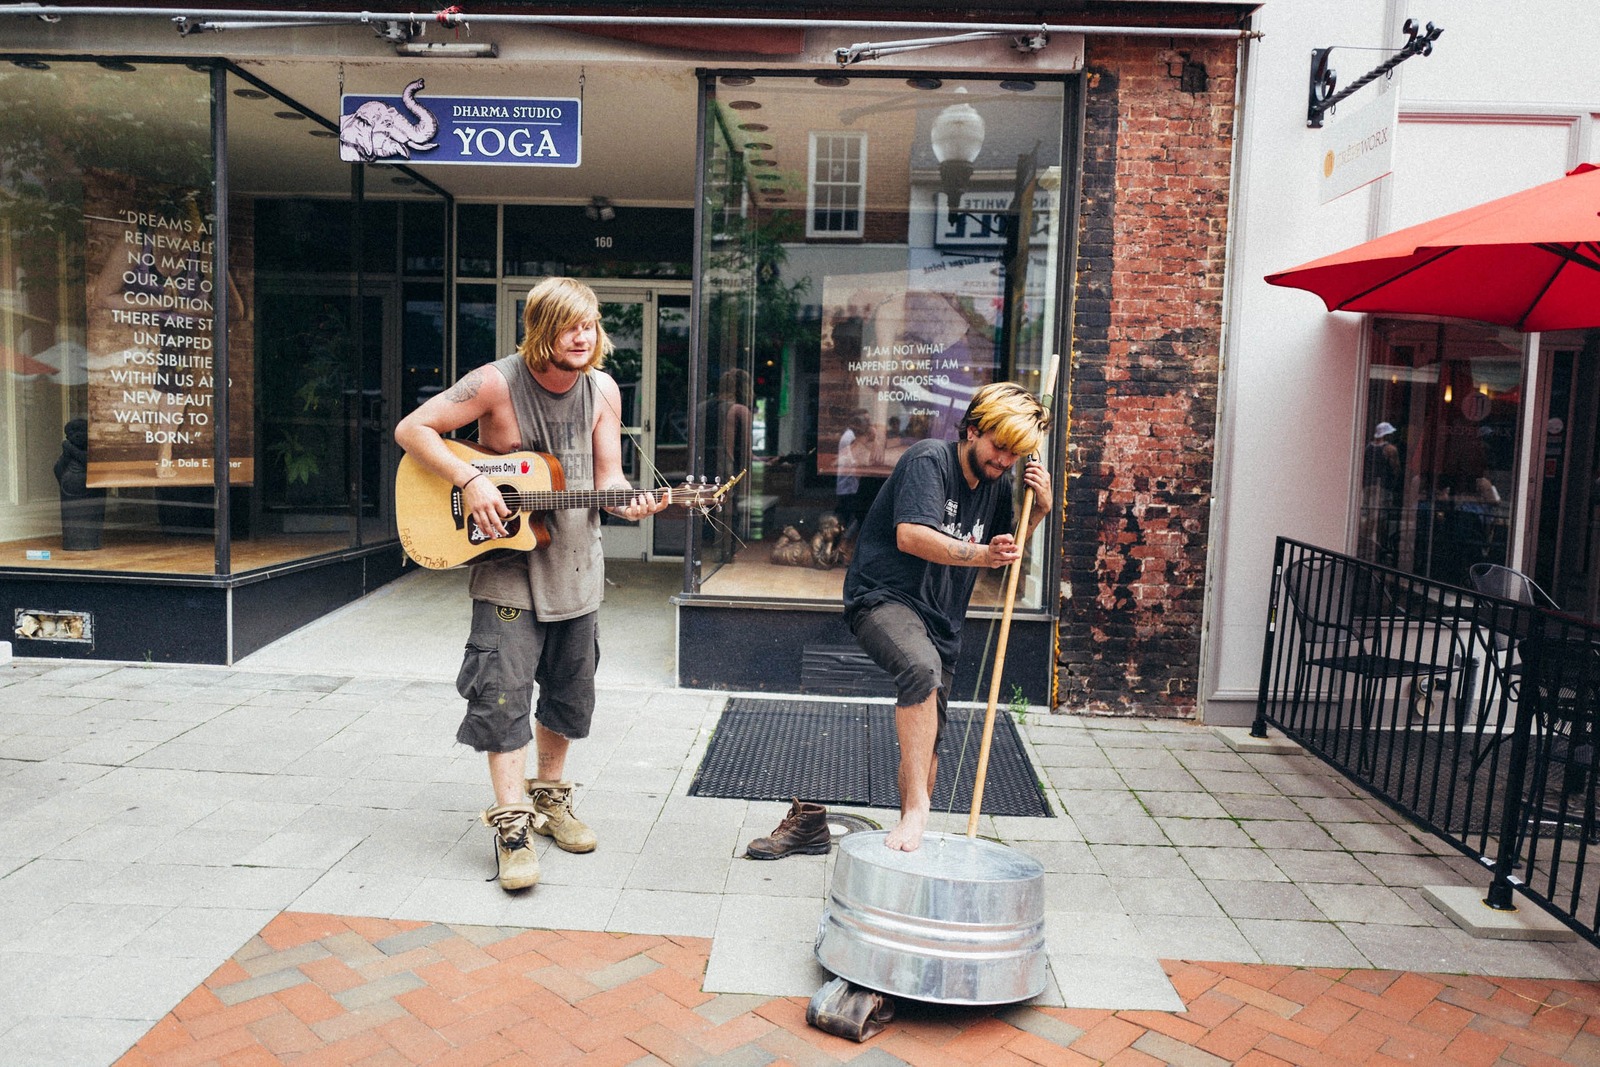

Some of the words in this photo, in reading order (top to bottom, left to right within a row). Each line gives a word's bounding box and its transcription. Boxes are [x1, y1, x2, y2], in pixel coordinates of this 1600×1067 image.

[453, 105, 509, 118] DHARMA
[513, 106, 562, 119] STUDIO
[453, 126, 560, 157] YOGA
[119, 209, 193, 233] “DREAMS
[594, 236, 613, 248] 160
[128, 251, 156, 266] NO
[161, 255, 213, 274] MATTE
[122, 271, 158, 287] OUR
[163, 277, 196, 291] AGE
[112, 309, 160, 327] THERE
[164, 315, 194, 330] ARE
[133, 331, 212, 350] UNTAPPED
[874, 346, 890, 356] AM
[893, 345, 915, 355] NOT
[917, 344, 945, 354] WHAT
[123, 351, 213, 369] POSSIBILITIE
[848, 361, 898, 372] HAPPENED
[901, 360, 915, 371] TO
[917, 360, 933, 372] ME,
[941, 359, 959, 370] AM
[111, 370, 170, 386] WITHIN
[174, 374, 194, 388] US
[856, 376, 884, 386] WHAT
[892, 376, 934, 386] CHOOSE
[936, 375, 950, 385] TO
[123, 390, 161, 405] NEW
[167, 393, 214, 407] BEAUT
[113, 410, 184, 425] WAITING
[188, 413, 208, 426] TO
[925, 408, 940, 418] Jung
[145, 431, 201, 444] BORN.”
[547, 421, 575, 450] THE
[161, 459, 175, 468] Dr.
[177, 459, 199, 468] Dale
[202, 459, 211, 468] E.
[503, 463, 516, 474] Only
